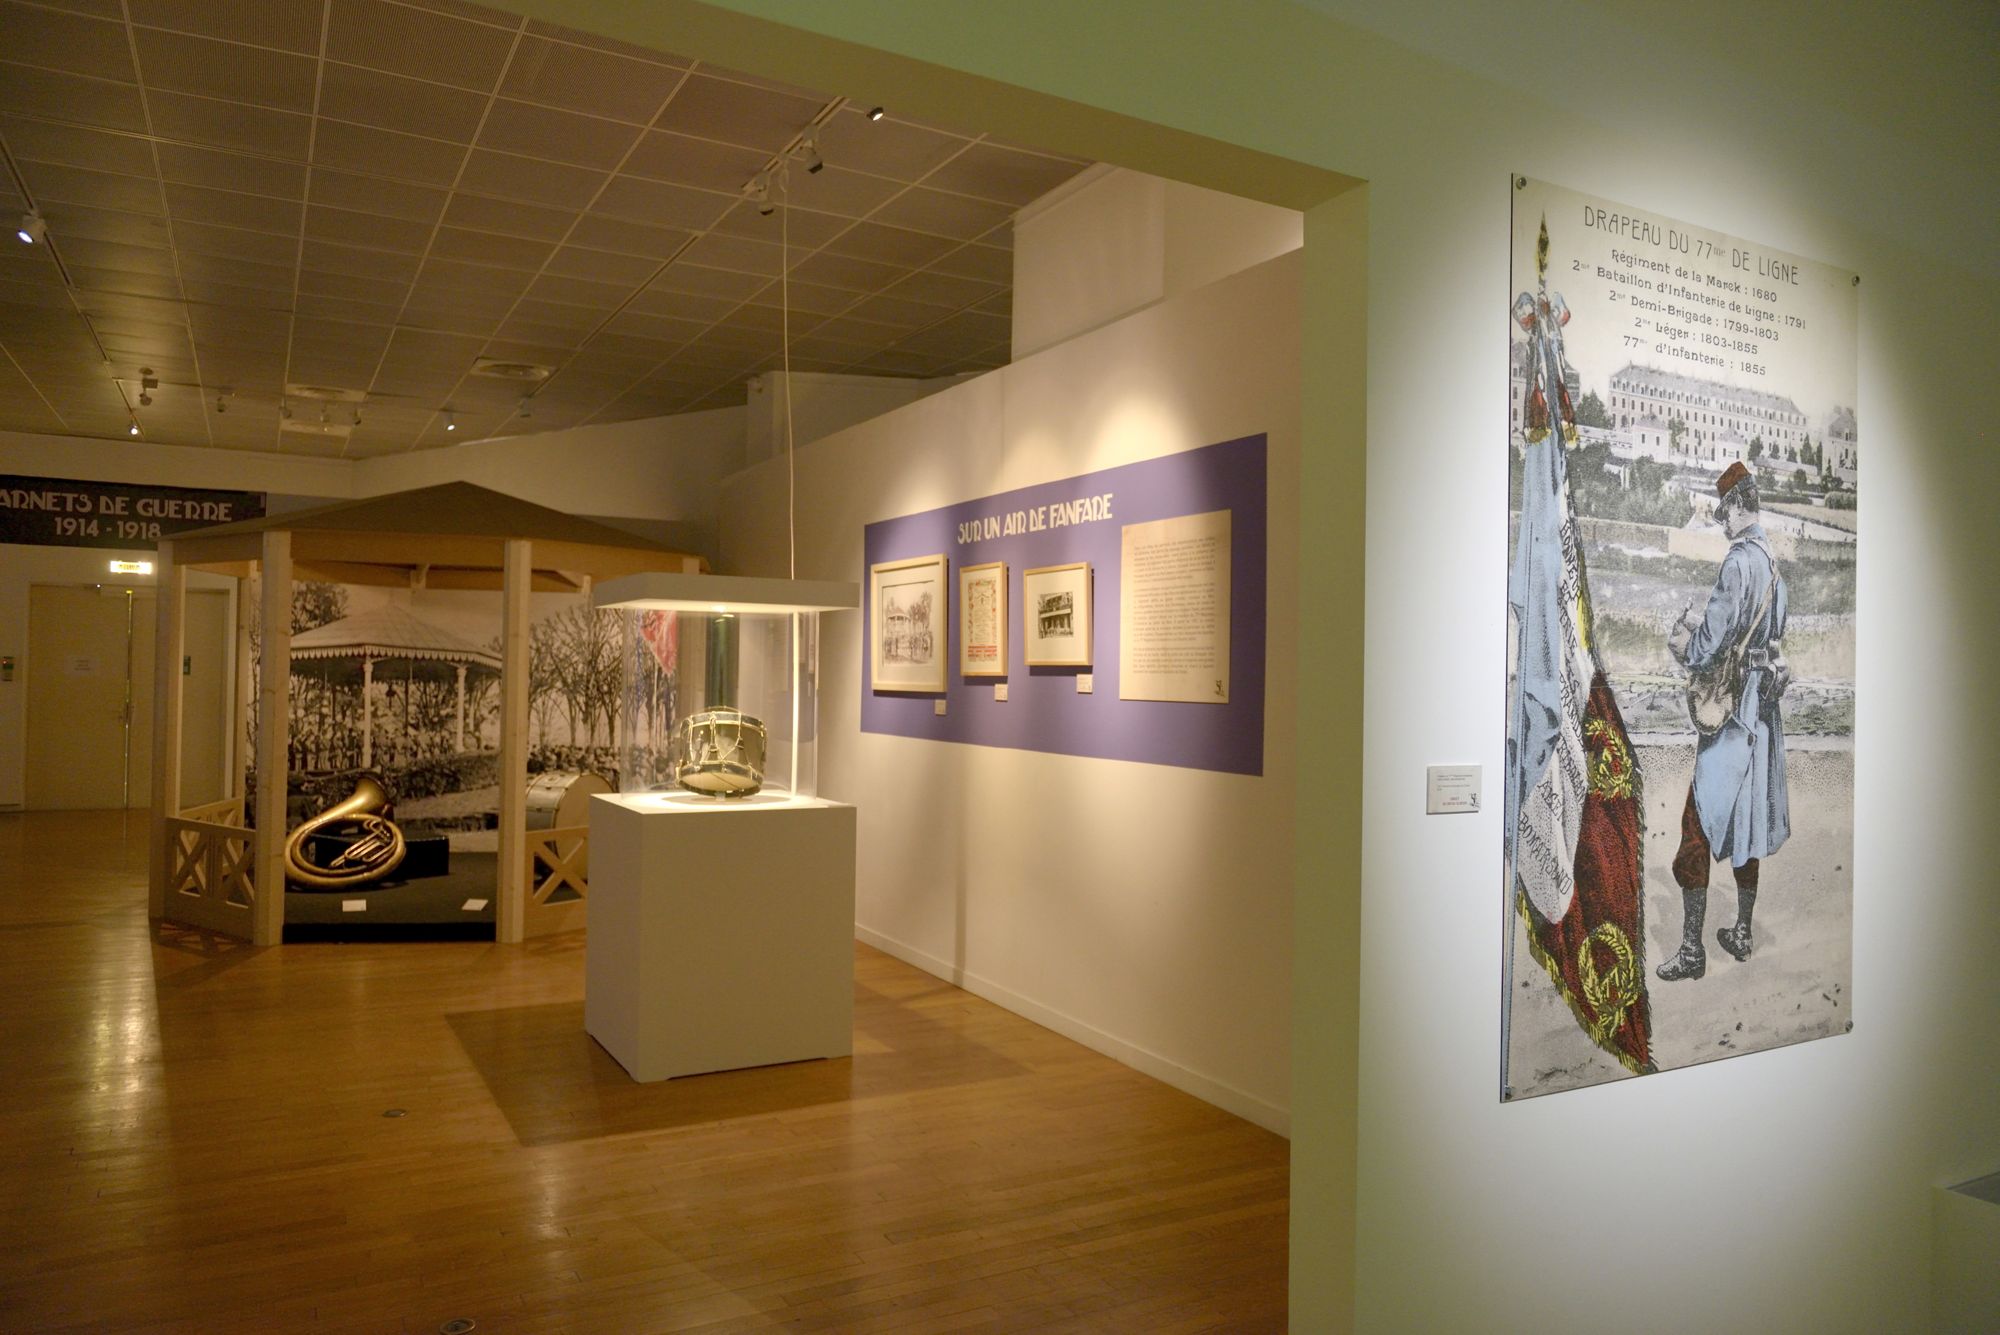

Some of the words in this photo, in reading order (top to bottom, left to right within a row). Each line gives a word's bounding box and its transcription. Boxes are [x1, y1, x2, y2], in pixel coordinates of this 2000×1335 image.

[1584, 205, 1661, 246] DRAPEAU
[1669, 229, 1689, 254] DU
[1732, 248, 1750, 272] DE
[1758, 255, 1799, 286] LIGNE
[1596, 266, 1652, 290] Bataillon
[1728, 300, 1741, 313] de
[1745, 304, 1775, 322] Ligne
[1784, 315, 1806, 330] 1791
[1611, 248, 1671, 274] Régiment
[1674, 266, 1689, 280] de
[1692, 270, 1702, 283] la
[1752, 287, 1777, 303] 1680
[1631, 295, 1712, 326] Demi-Brigade
[1723, 318, 1780, 342] 1799-1803
[1655, 321, 1689, 340] Léger
[1700, 332, 1759, 356] 1803-1855
[1740, 361, 1766, 376] 1855
[54, 517, 99, 537] 1914
[117, 520, 161, 540] 1918
[99, 495, 130, 516] DE
[136, 498, 233, 522] GUERRE
[957, 520, 982, 545] SUR
[984, 515, 1001, 540] UN
[1003, 511, 1027, 537] AIR
[1029, 506, 1047, 532] DE
[1050, 493, 1113, 528] FANFARE
